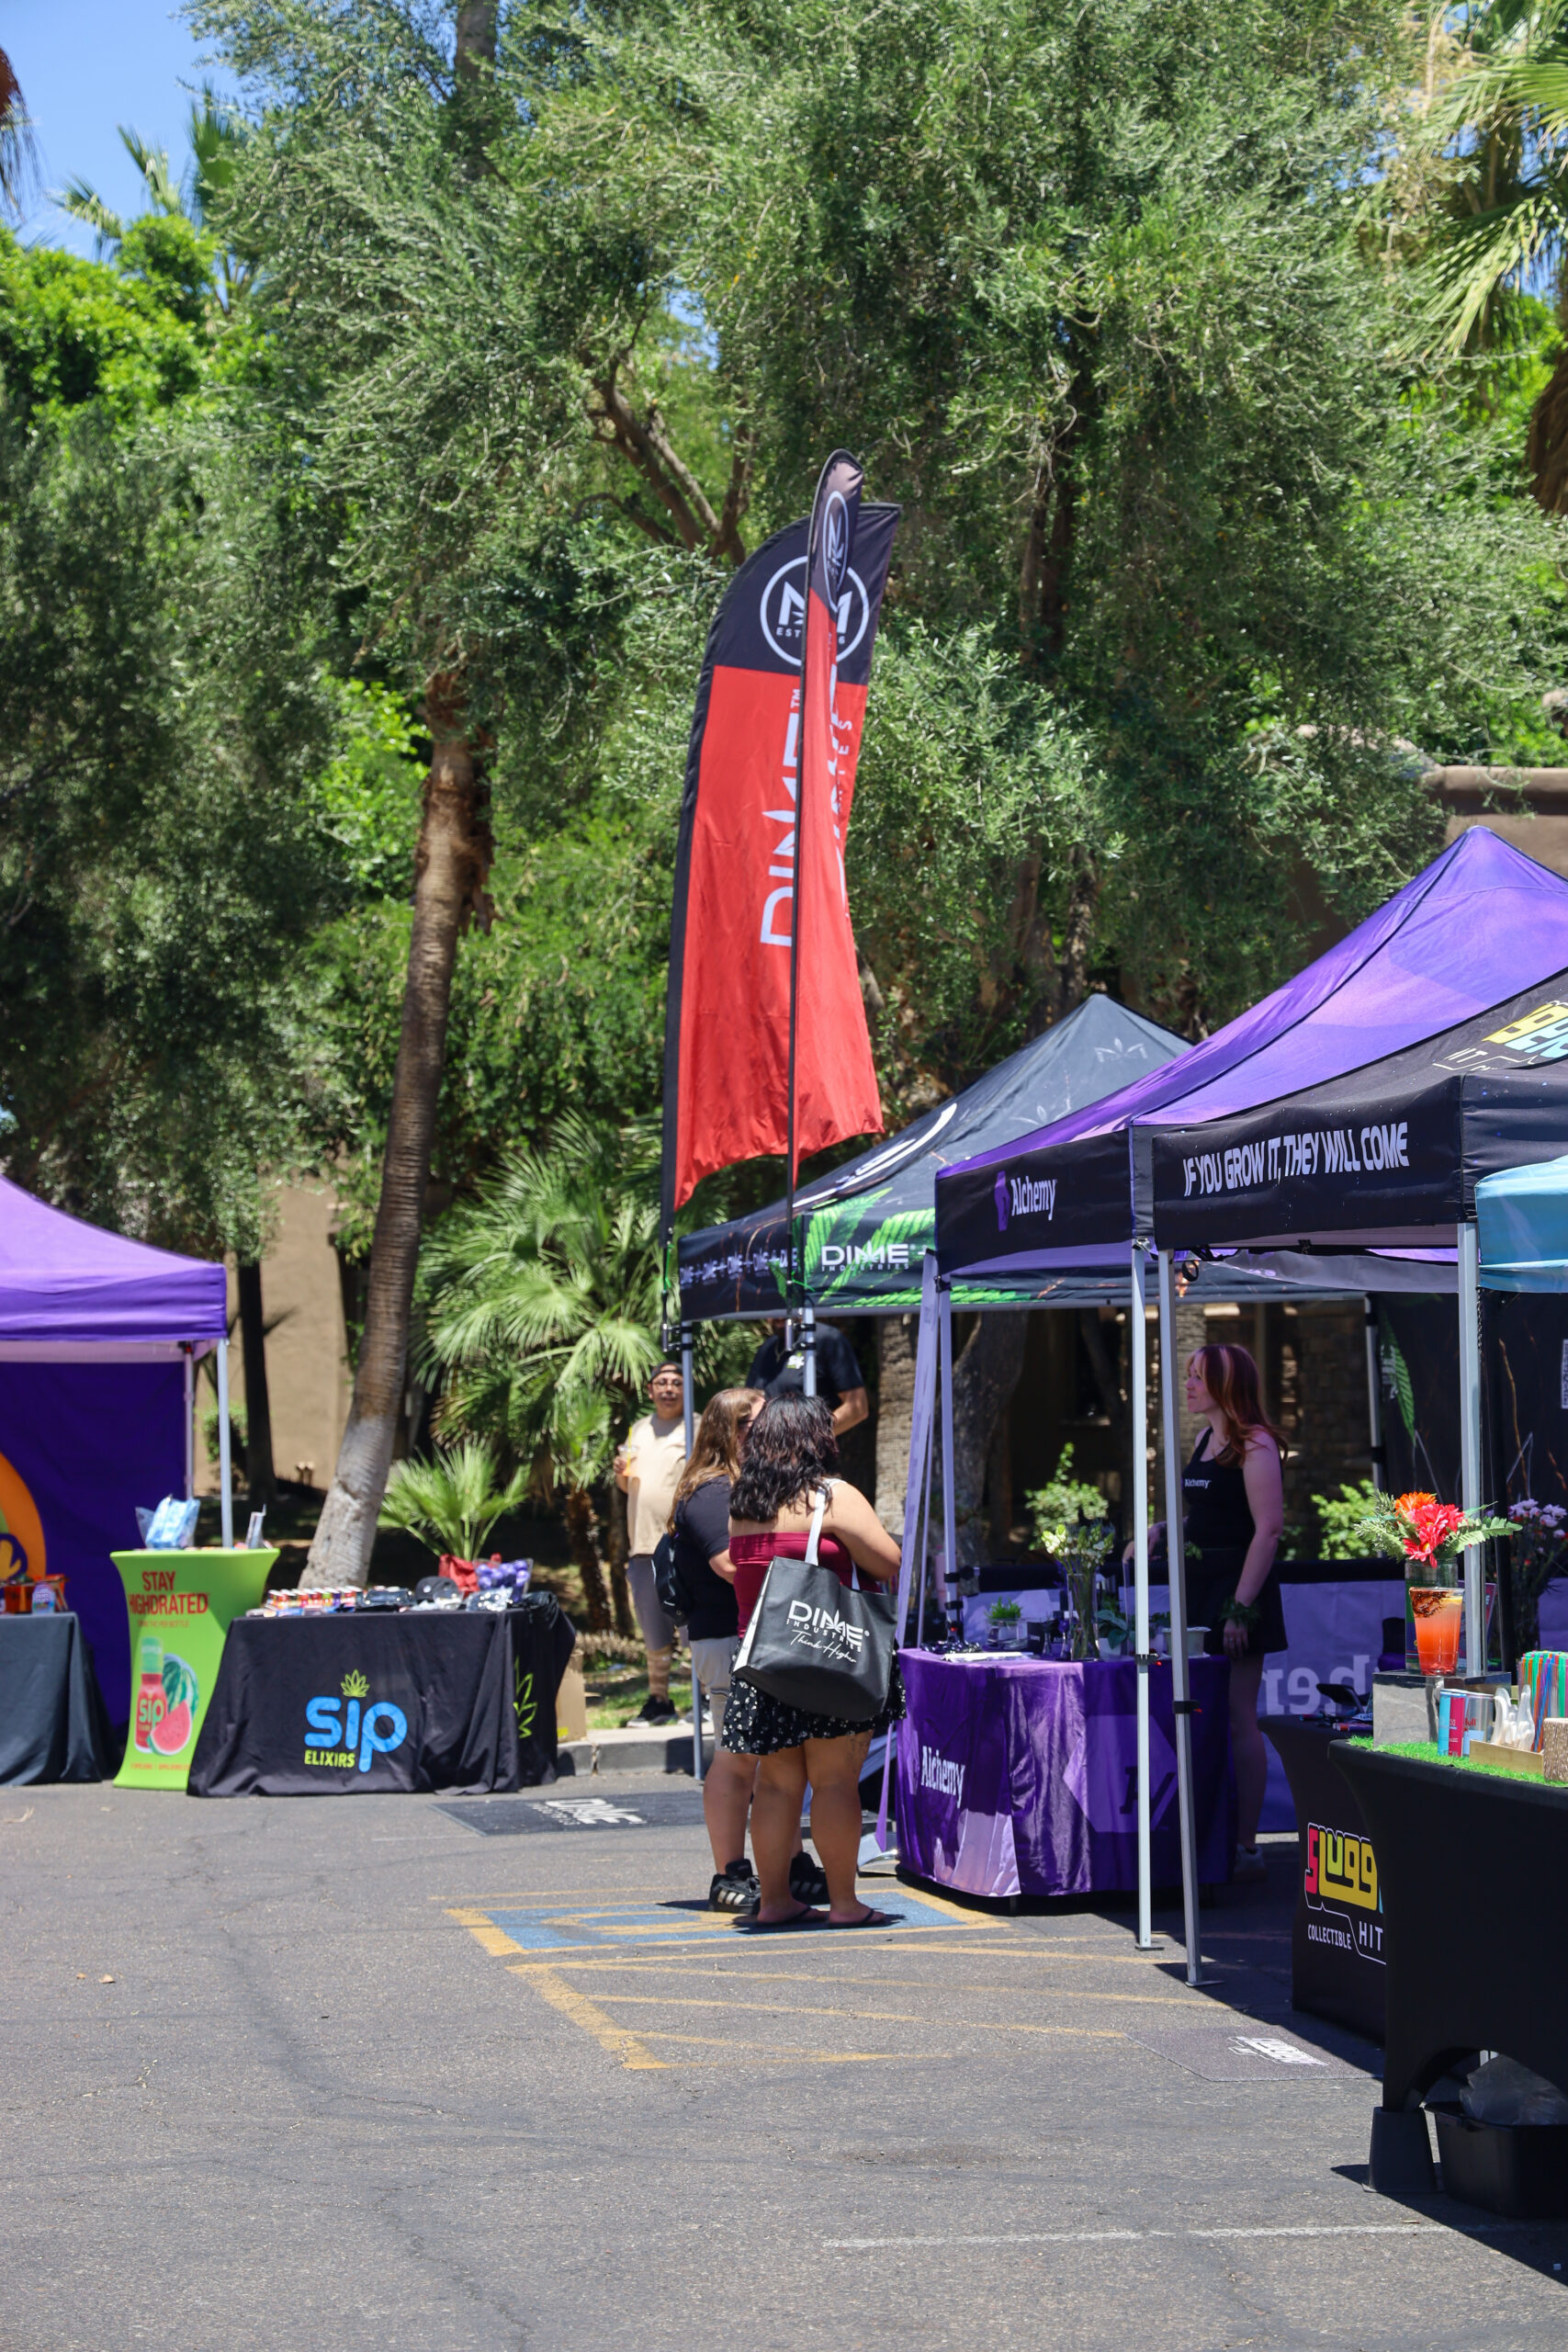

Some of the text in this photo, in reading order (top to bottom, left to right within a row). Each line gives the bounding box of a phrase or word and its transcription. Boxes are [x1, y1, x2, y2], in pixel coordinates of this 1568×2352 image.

[1183, 1158, 1197, 1196] IF
[1195, 1152, 1223, 1194] YOU
[1224, 1140, 1266, 1190] GROW
[1283, 1132, 1319, 1177] THEY
[1320, 1129, 1361, 1173] WILL
[1360, 1122, 1410, 1170] COME
[1010, 1175, 1055, 1221] Alchemy
[821, 1240, 909, 1266] DIME
[821, 1263, 909, 1272] INDUSTRIES
[141, 1570, 176, 1591] STAY
[786, 1619, 862, 1653] INDUSTRIES
[788, 1600, 863, 1647] DIME
[790, 1629, 857, 1663] Think Higher
[304, 1749, 355, 1768] ELIXIRS
[920, 1745, 965, 1809] Alchemy
[1305, 1826, 1383, 1914] SLUGG
[1307, 1920, 1383, 1951] COLLECTIBLE HIT
